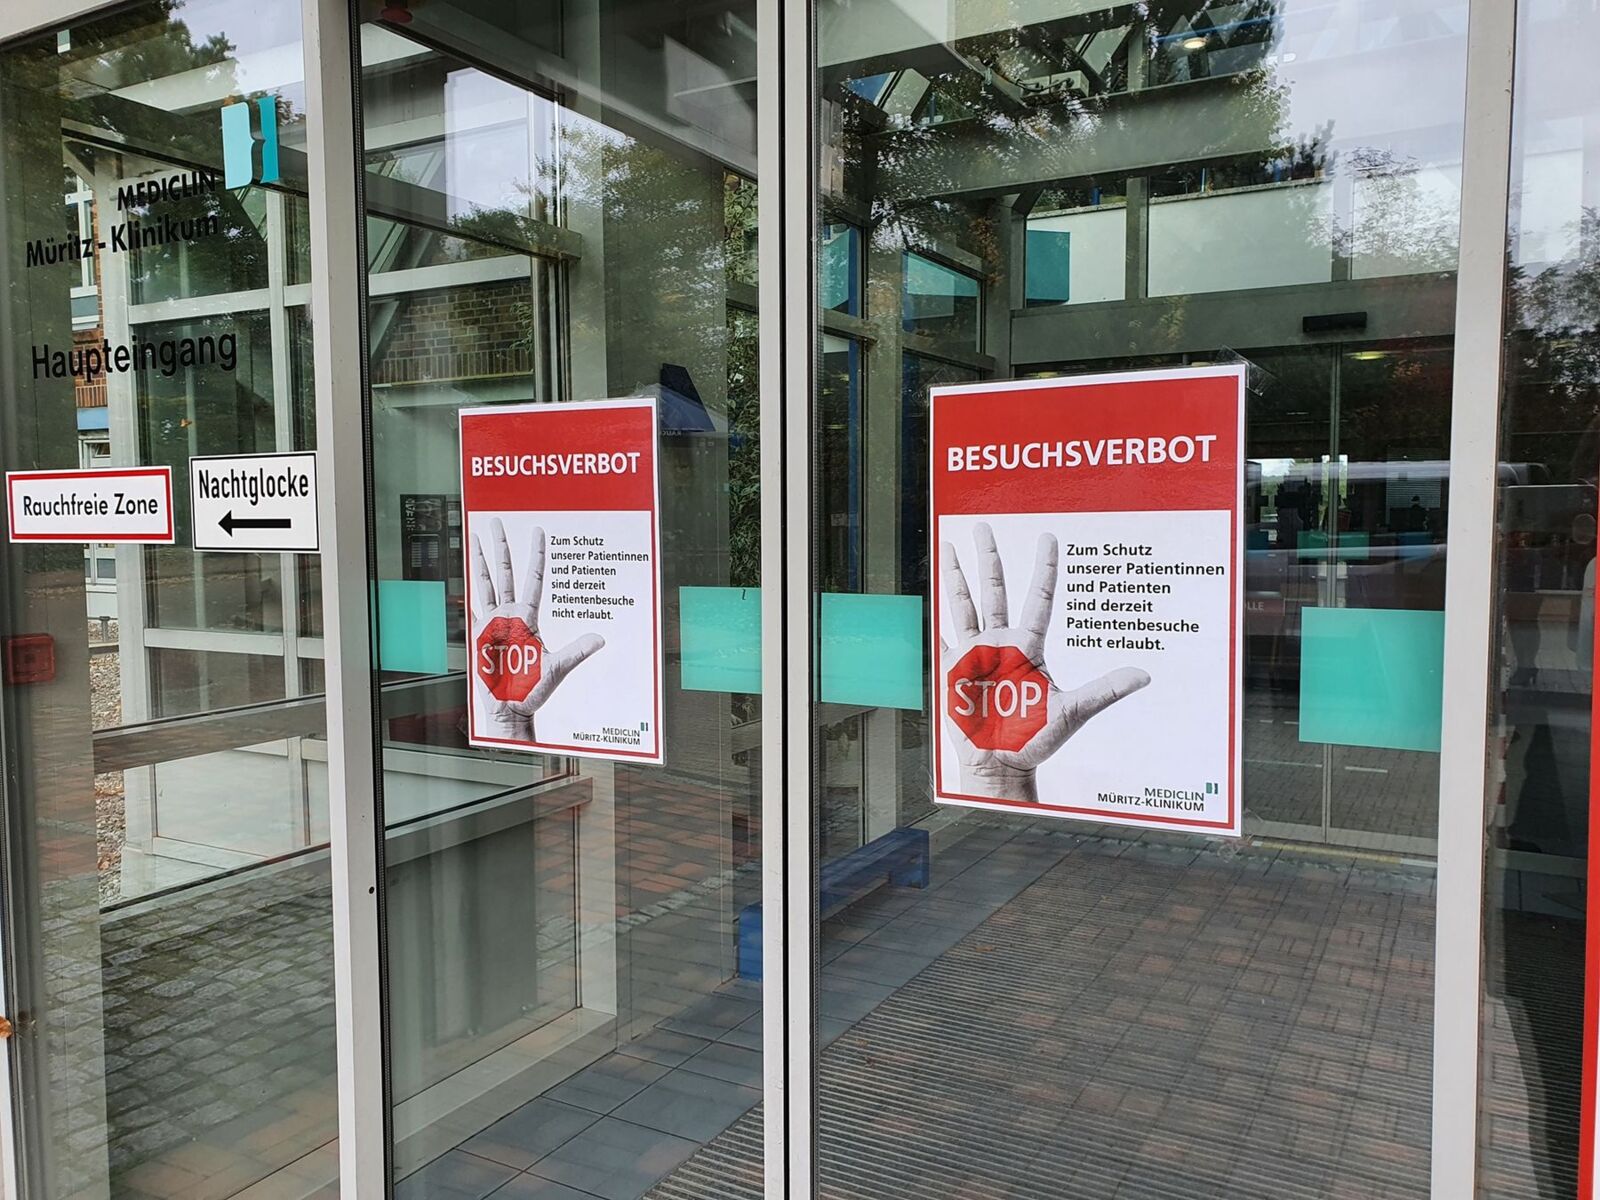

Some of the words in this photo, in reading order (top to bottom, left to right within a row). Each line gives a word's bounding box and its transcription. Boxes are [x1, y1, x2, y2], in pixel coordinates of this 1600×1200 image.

[117, 170, 216, 211] MEDICLIN
[31, 332, 237, 383] Haupteingang
[947, 435, 1217, 472] BESUCHSVERBOT
[471, 452, 640, 476] BESUCHSVERBOT
[199, 466, 309, 506] Nachtglocke
[23, 493, 108, 516] Rauchfreie
[114, 493, 159, 515] Zone
[550, 536, 571, 546] Zum
[573, 535, 604, 547] Schutz
[551, 552, 585, 562] unserer
[588, 550, 649, 562] Patientinnen
[1066, 544, 1099, 556] Zum
[1103, 543, 1153, 556] Schutz
[551, 565, 569, 575] und
[572, 565, 616, 576] Patienten
[1066, 562, 1122, 575] unserer
[1126, 562, 1225, 576] Patientinnen
[551, 579, 570, 590] sind
[573, 580, 605, 591] derzeit
[1066, 581, 1095, 593] und
[1099, 581, 1171, 594] Patienten
[551, 594, 635, 606] Patientenbesuche
[1066, 600, 1096, 612] sind
[1101, 599, 1153, 613] derzeit
[551, 608, 575, 619] nicht
[577, 609, 614, 620] erlaubt.
[1066, 617, 1200, 633] Patientenbesuche
[1066, 636, 1102, 649] nicht
[1106, 637, 1165, 651] erlaubt.
[481, 643, 538, 675] STOP
[954, 677, 1043, 719] STOP
[573, 732, 640, 745] MÜRITZ-KLINIKUM
[602, 727, 640, 737] MEDICLIN
[1144, 787, 1205, 801] MEDICLIN
[1097, 792, 1205, 812] MÜRITZ-KLINIKUM
